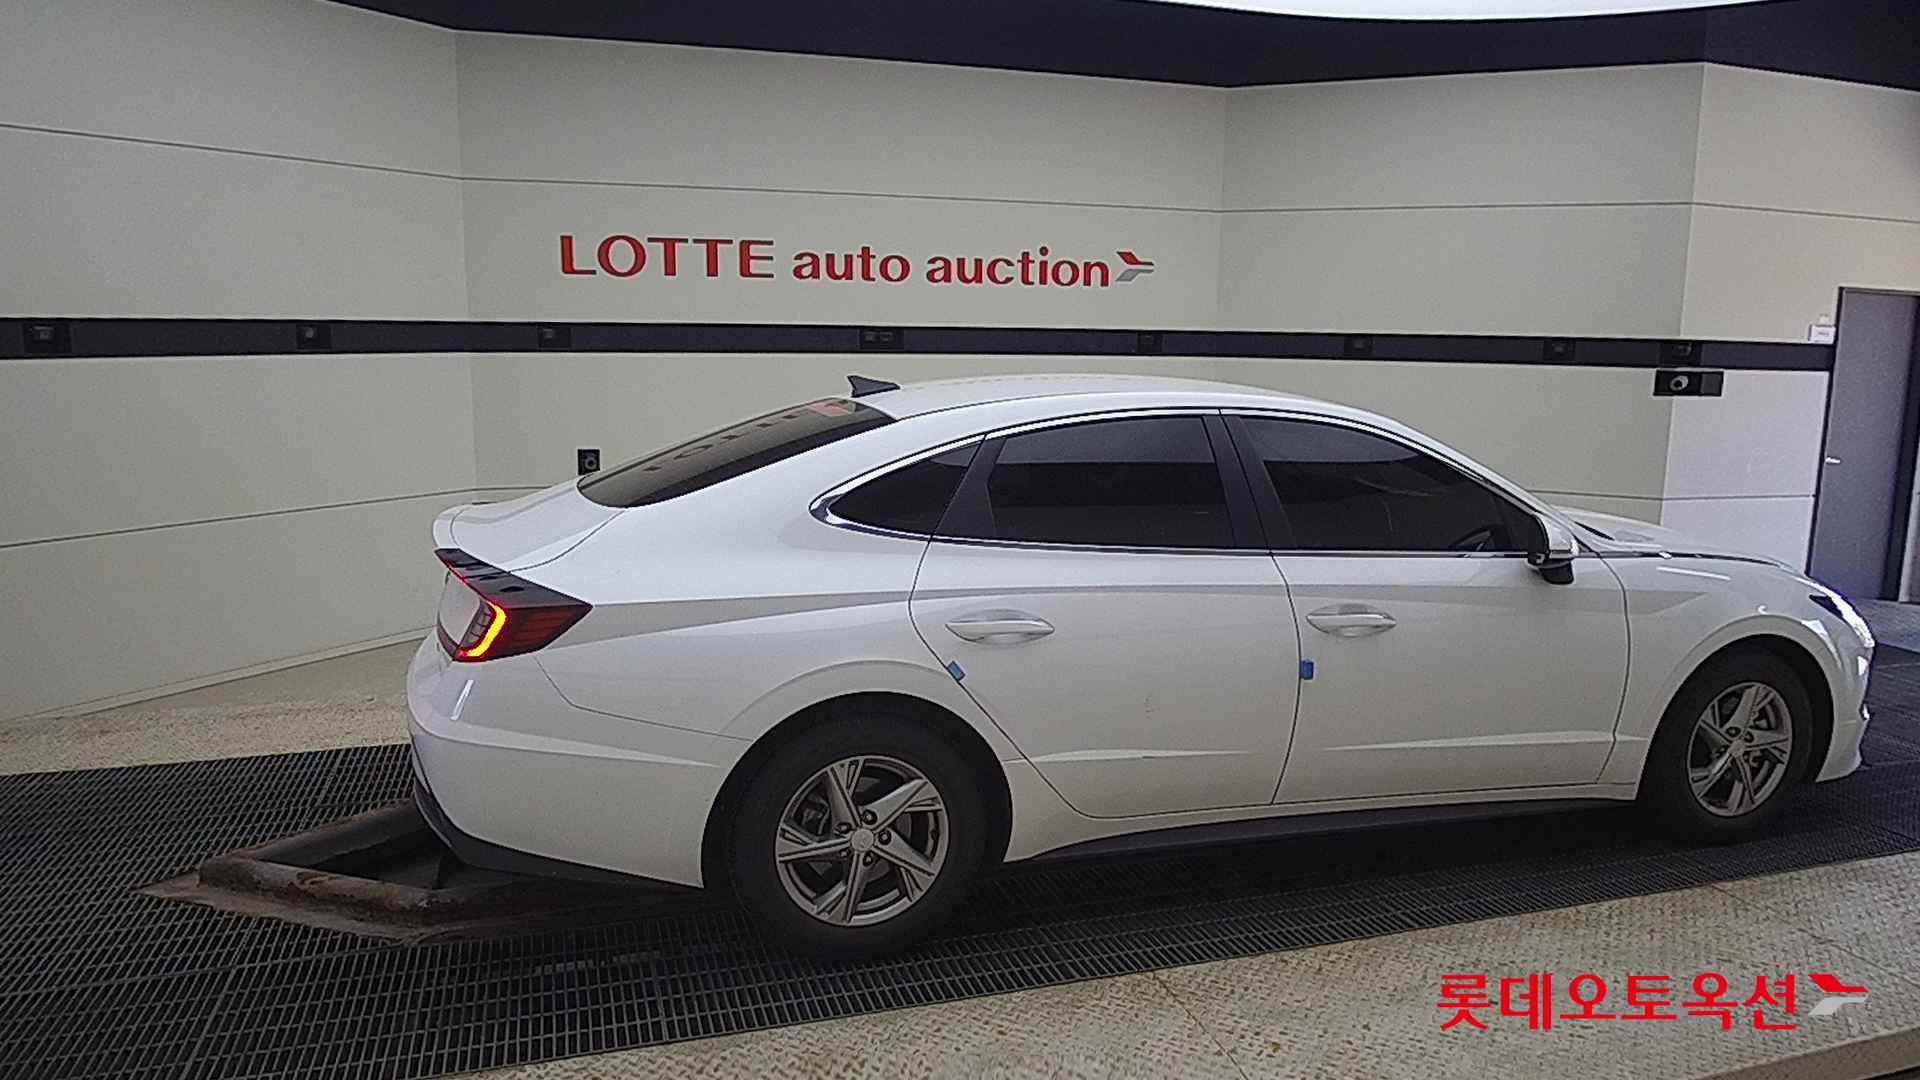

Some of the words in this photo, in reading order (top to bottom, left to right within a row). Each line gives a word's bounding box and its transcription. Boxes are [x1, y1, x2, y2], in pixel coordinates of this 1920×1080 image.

[560, 235, 774, 278] LOTTE
[793, 246, 911, 283] auto
[926, 247, 1110, 287] auction
